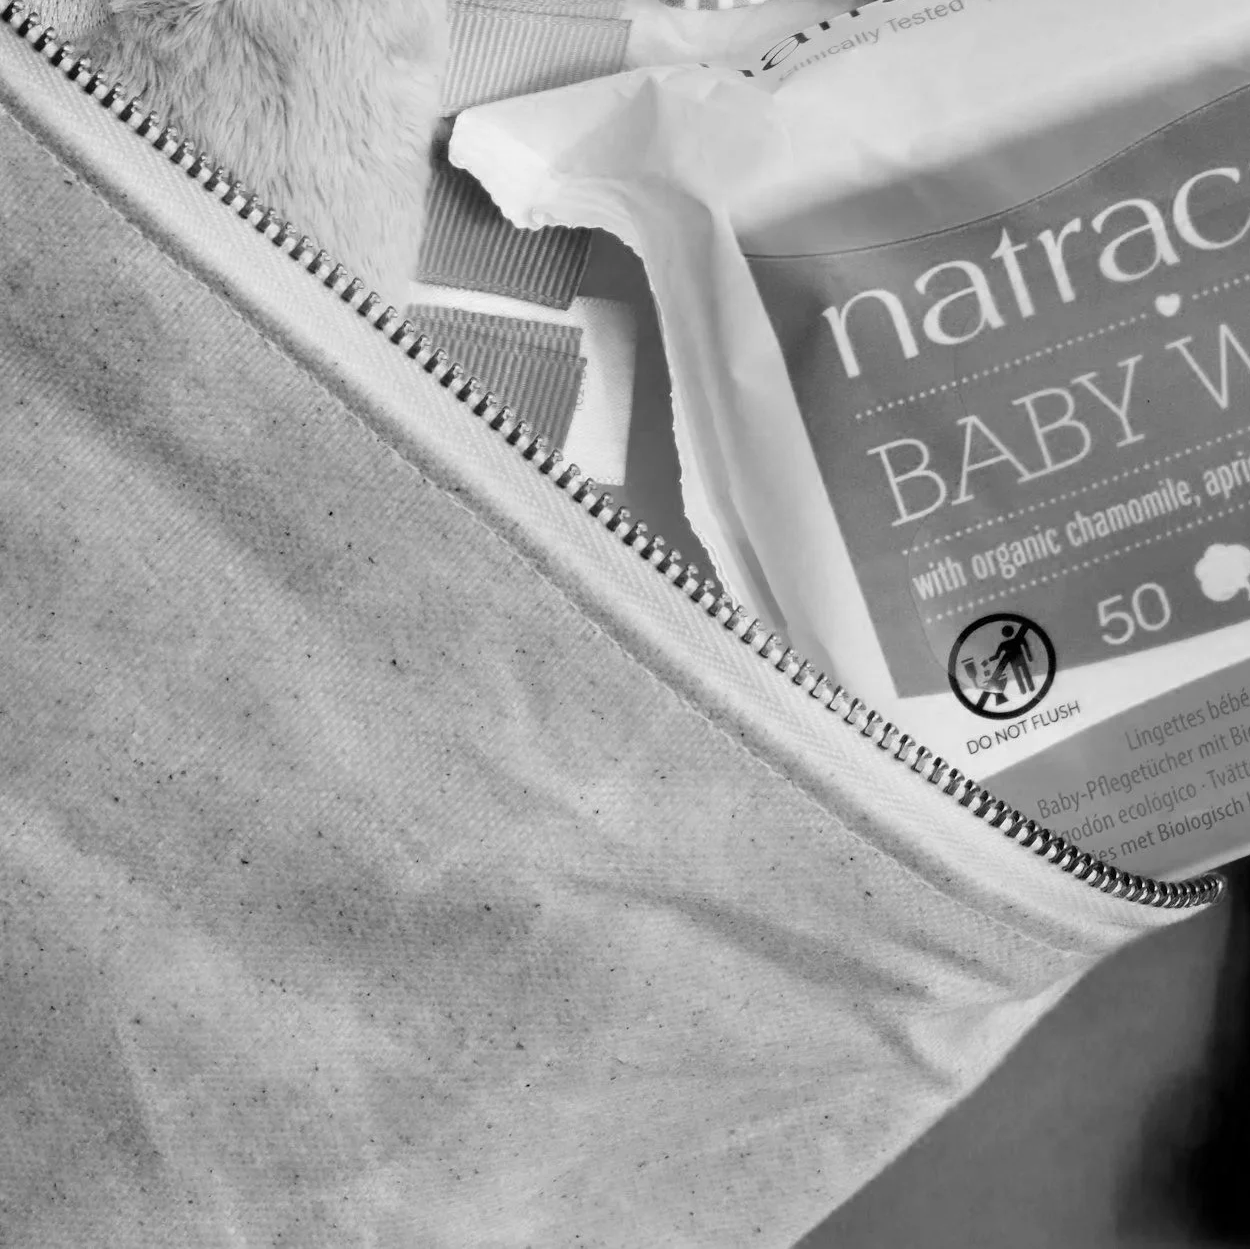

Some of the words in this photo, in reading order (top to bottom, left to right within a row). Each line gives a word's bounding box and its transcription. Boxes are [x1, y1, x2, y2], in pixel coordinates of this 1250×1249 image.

[866, 354, 1146, 526] BABY
[911, 556, 967, 600] with
[971, 524, 1062, 580] organic
[1066, 478, 1202, 547] chamomile,
[1097, 582, 1172, 645] 50
[966, 735, 992, 755] DO
[994, 719, 1028, 745] NOT
[1030, 700, 1081, 730] FLUSH
[1124, 710, 1205, 751] Lingettes
[1036, 748, 1195, 819] Baby-Pflegetücher
[1197, 734, 1229, 759] mit
[1118, 782, 1198, 824] ecológico
[1120, 832, 1155, 857] met
[1157, 796, 1246, 843] Biologisch
